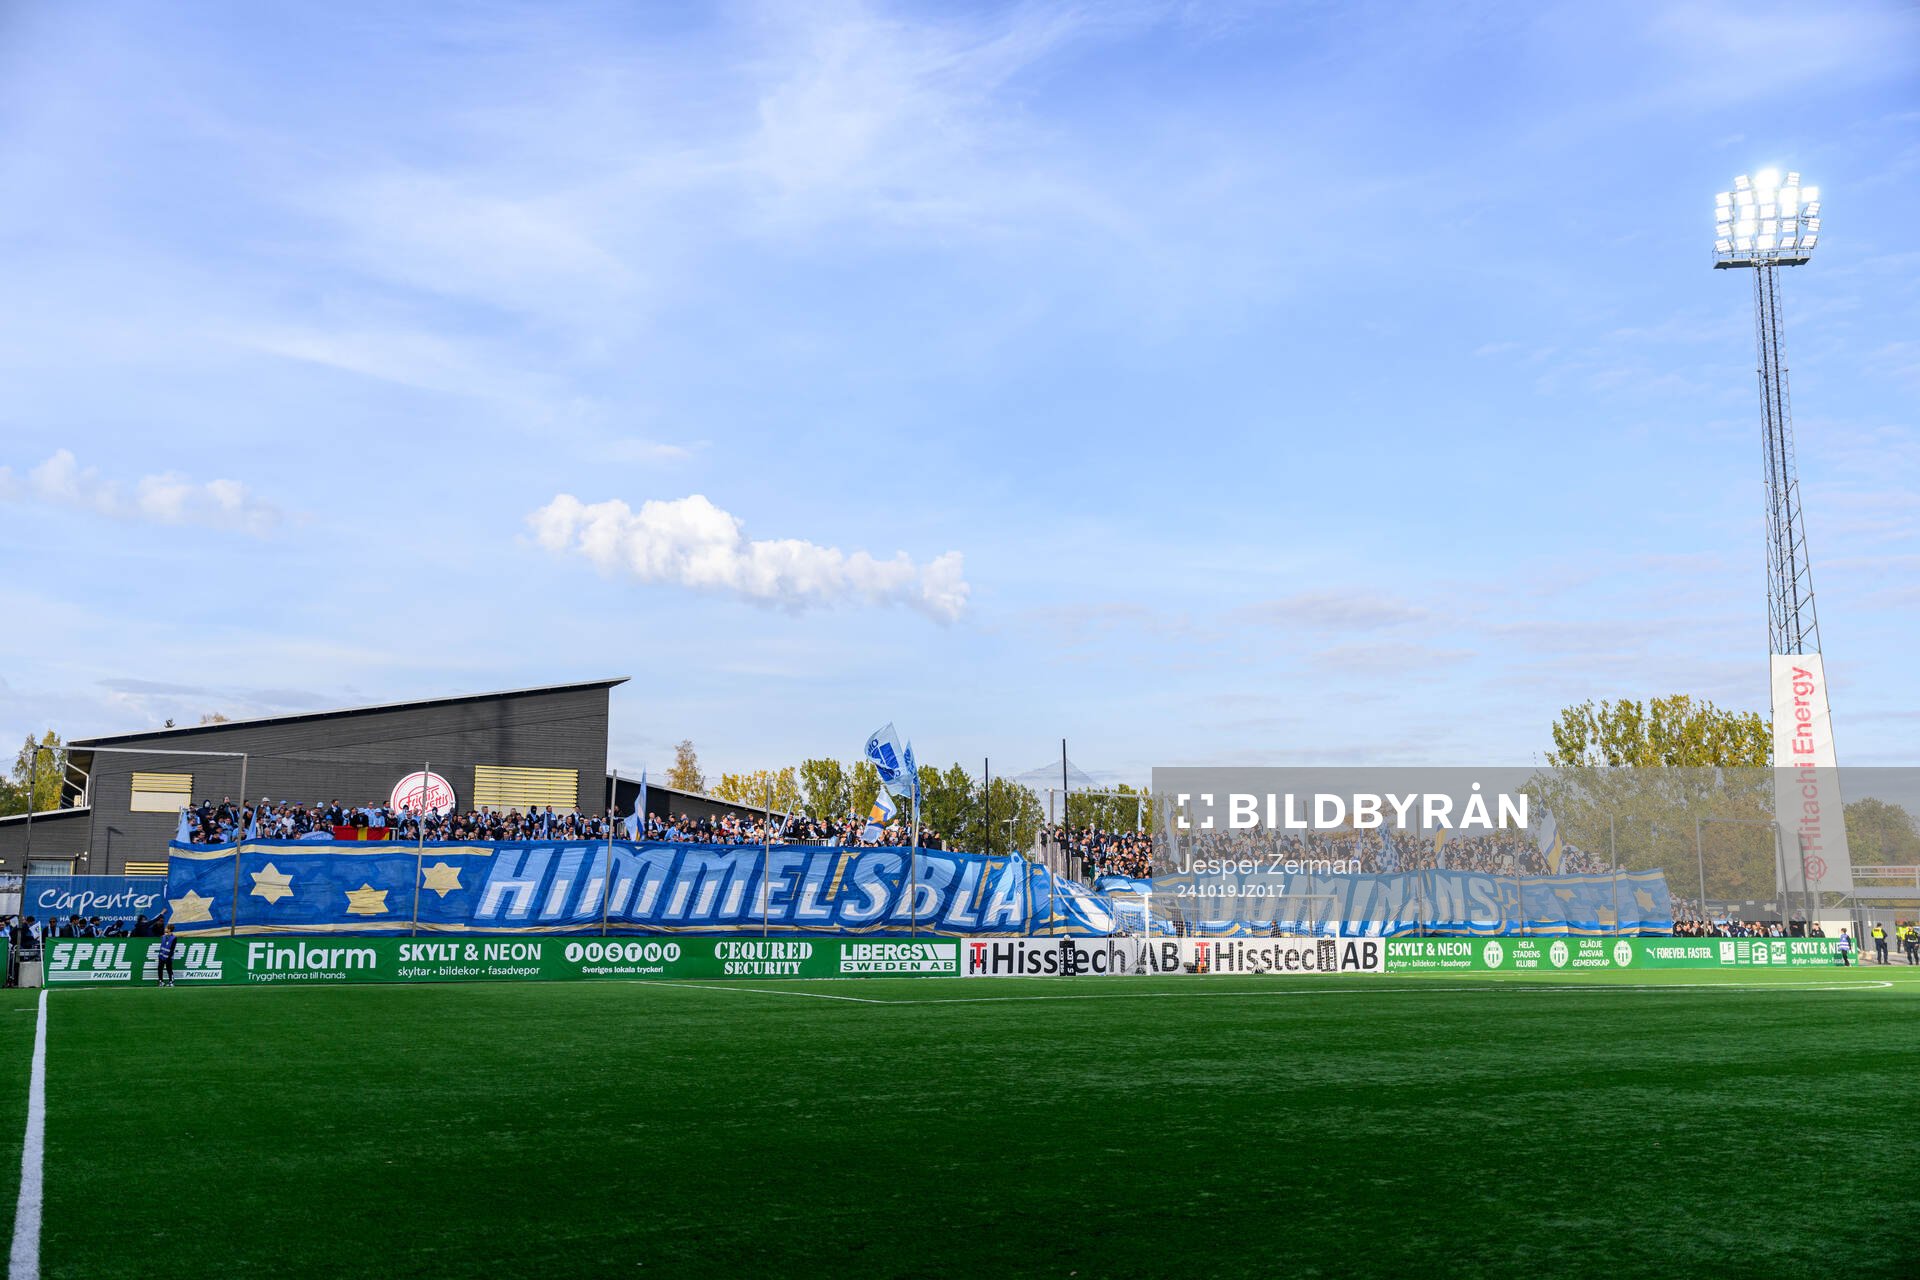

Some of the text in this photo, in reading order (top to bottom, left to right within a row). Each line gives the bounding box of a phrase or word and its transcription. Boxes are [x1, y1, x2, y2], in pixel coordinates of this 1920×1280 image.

[1792, 666, 1823, 851] Hitachi Energy
[38, 887, 160, 915] Carpenter
[714, 941, 813, 960] CEQURED
[1388, 942, 1472, 956] SKYLT & NEON
[1518, 941, 1534, 949] HELA
[1580, 939, 1602, 948] GLÄDJE
[1791, 942, 1818, 954] SKYLT
[1820, 942, 1827, 954] &
[49, 943, 132, 969] SPOL
[247, 942, 377, 970] Finlarm
[399, 943, 541, 962] SKYLT & NEON
[841, 944, 924, 960] LIBERGS
[992, 941, 1126, 974] Hissech
[1341, 942, 1378, 970] AB
[1512, 950, 1541, 958] STADENS
[1579, 949, 1604, 957] ANSVAR
[724, 961, 802, 975] SECURITY
[843, 961, 954, 971] SWEDEN AB
[1572, 959, 1610, 967] GEMENSKAP
[248, 972, 286, 982] Trygghet
[288, 972, 308, 980] nära
[398, 965, 541, 978] skyltar bildekor fasadvepor
[582, 966, 613, 975] Sveriges
[637, 966, 663, 974] tryckeri
